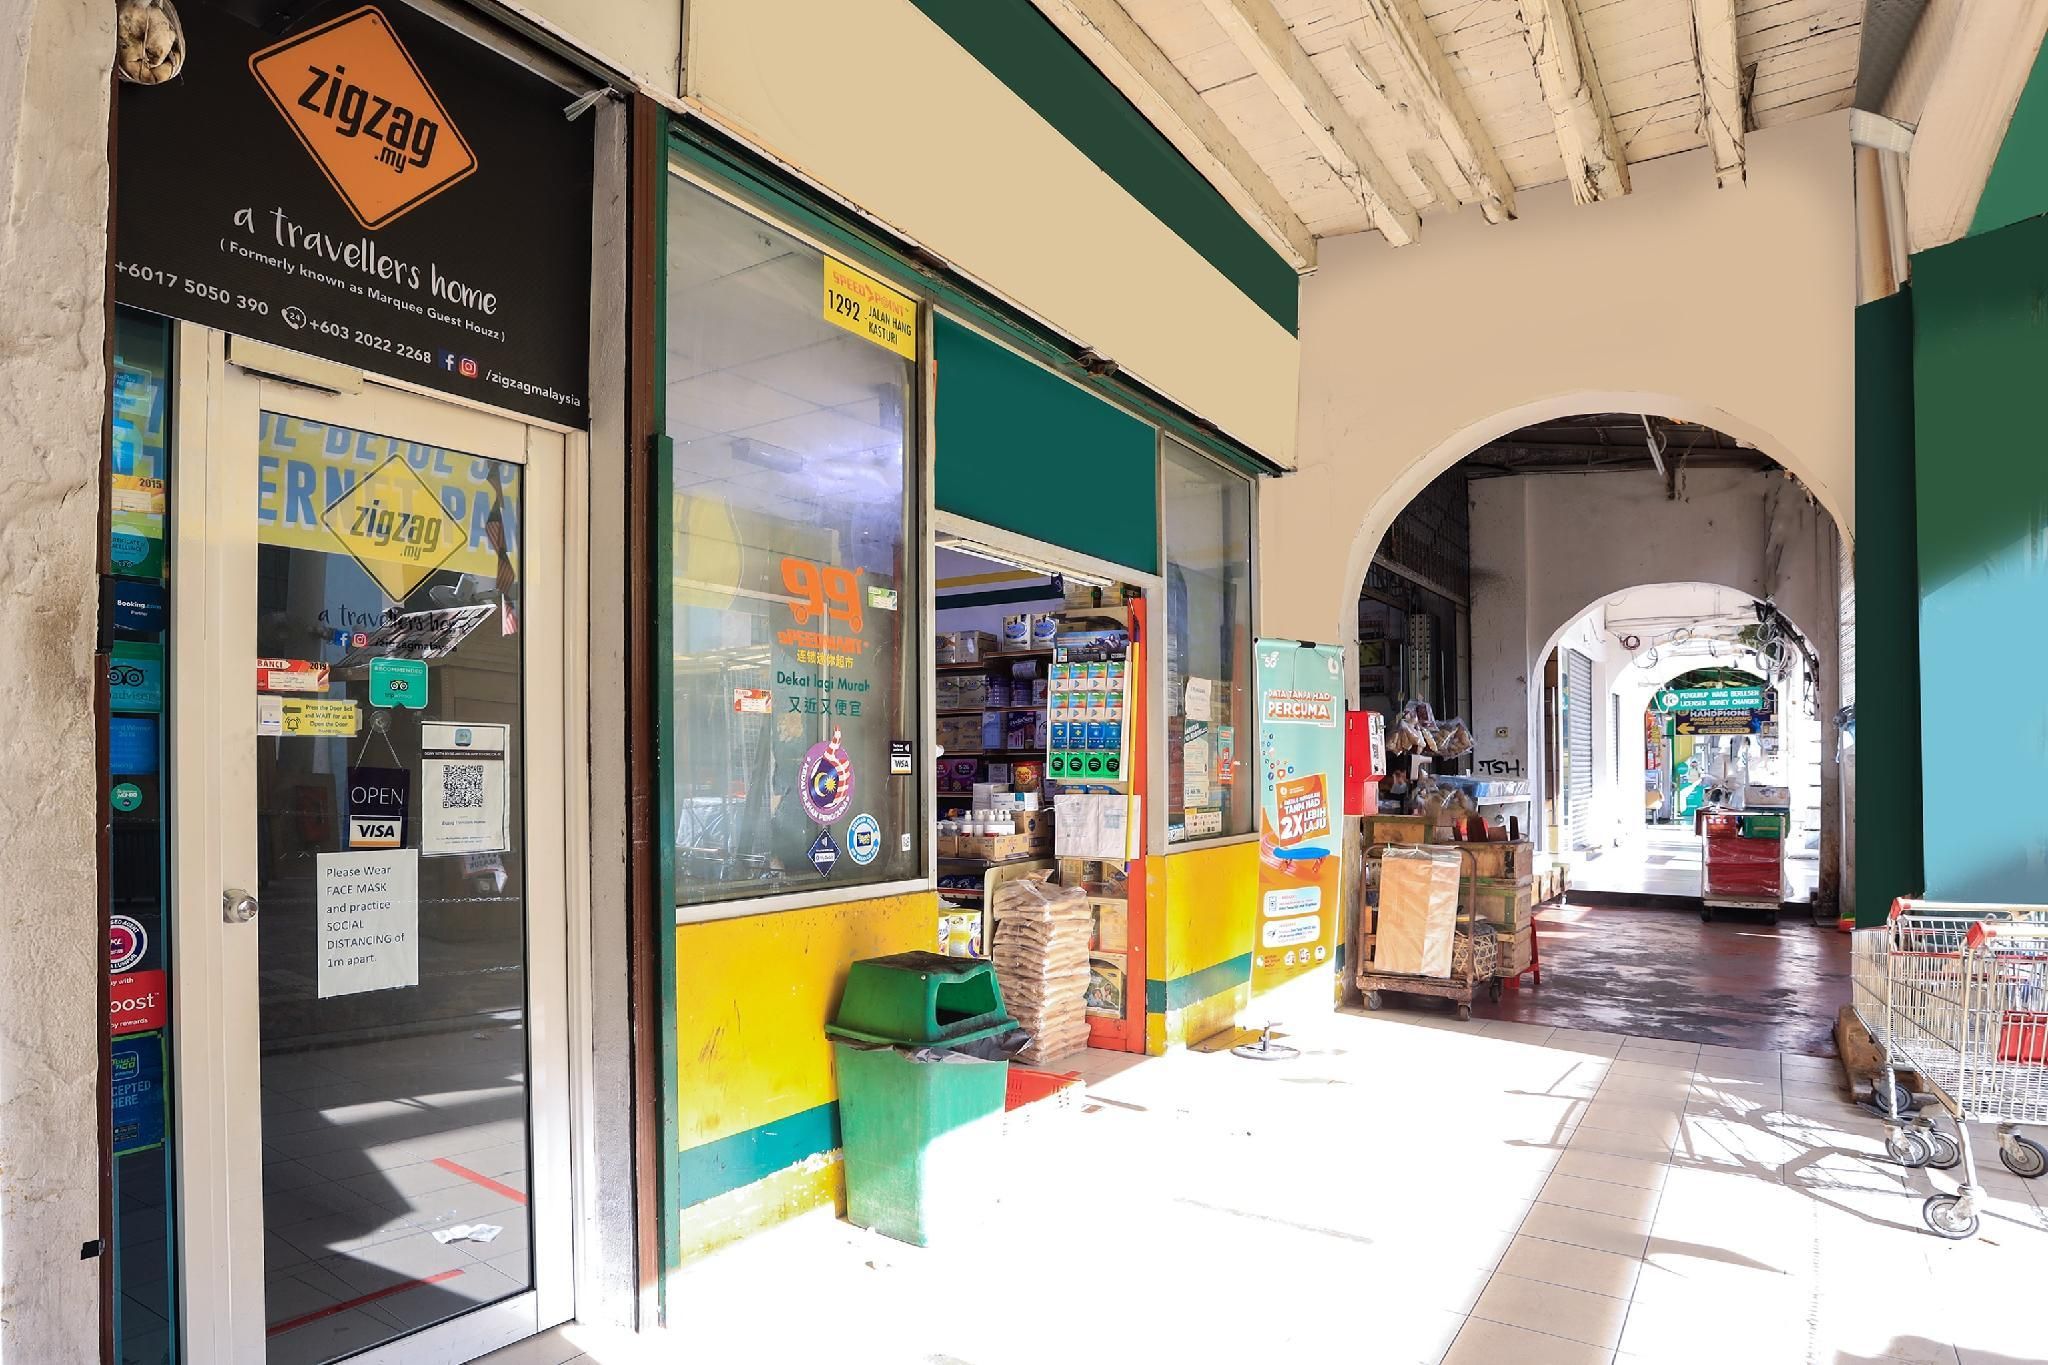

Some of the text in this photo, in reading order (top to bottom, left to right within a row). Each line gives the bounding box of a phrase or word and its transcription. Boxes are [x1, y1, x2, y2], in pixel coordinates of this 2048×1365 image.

[298, 64, 439, 168] zigzag
[233, 206, 497, 315] a travellers home
[115, 261, 269, 315] +6017 5050 390
[230, 241, 296, 275] Formerly
[300, 263, 345, 289] known
[349, 284, 363, 295] as
[368, 287, 423, 315] Marquee
[427, 307, 462, 328] Guest
[829, 289, 860, 322] 1292
[868, 305, 912, 337] JALAN HANG
[309, 319, 432, 364] +603 2022 2268
[868, 321, 898, 345] KASTURI
[485, 369, 581, 407] /zigzagmalaysia
[139, 478, 162, 489] 2015
[350, 499, 442, 553] zigzag
[781, 557, 864, 634] 99
[310, 662, 327, 671] 2019
[776, 671, 870, 692] Dekat lagi Murah
[1268, 701, 1331, 720] PERCUMA
[1690, 710, 1751, 718] HANDPHONE
[351, 786, 404, 805] OPEN
[1303, 807, 1327, 820] LEBIH
[357, 824, 395, 838] VISA
[1280, 812, 1304, 840] 2X
[1303, 817, 1327, 833] LAJU
[326, 866, 391, 878] Please Wear
[326, 882, 387, 896] FACE MASK
[326, 901, 391, 914] and practice
[326, 919, 364, 932] SOCIAL
[327, 932, 405, 950] DISTANCING of
[327, 954, 377, 968] 1m apart.
[118, 977, 134, 985] with
[120, 1017, 148, 1027] rewards
